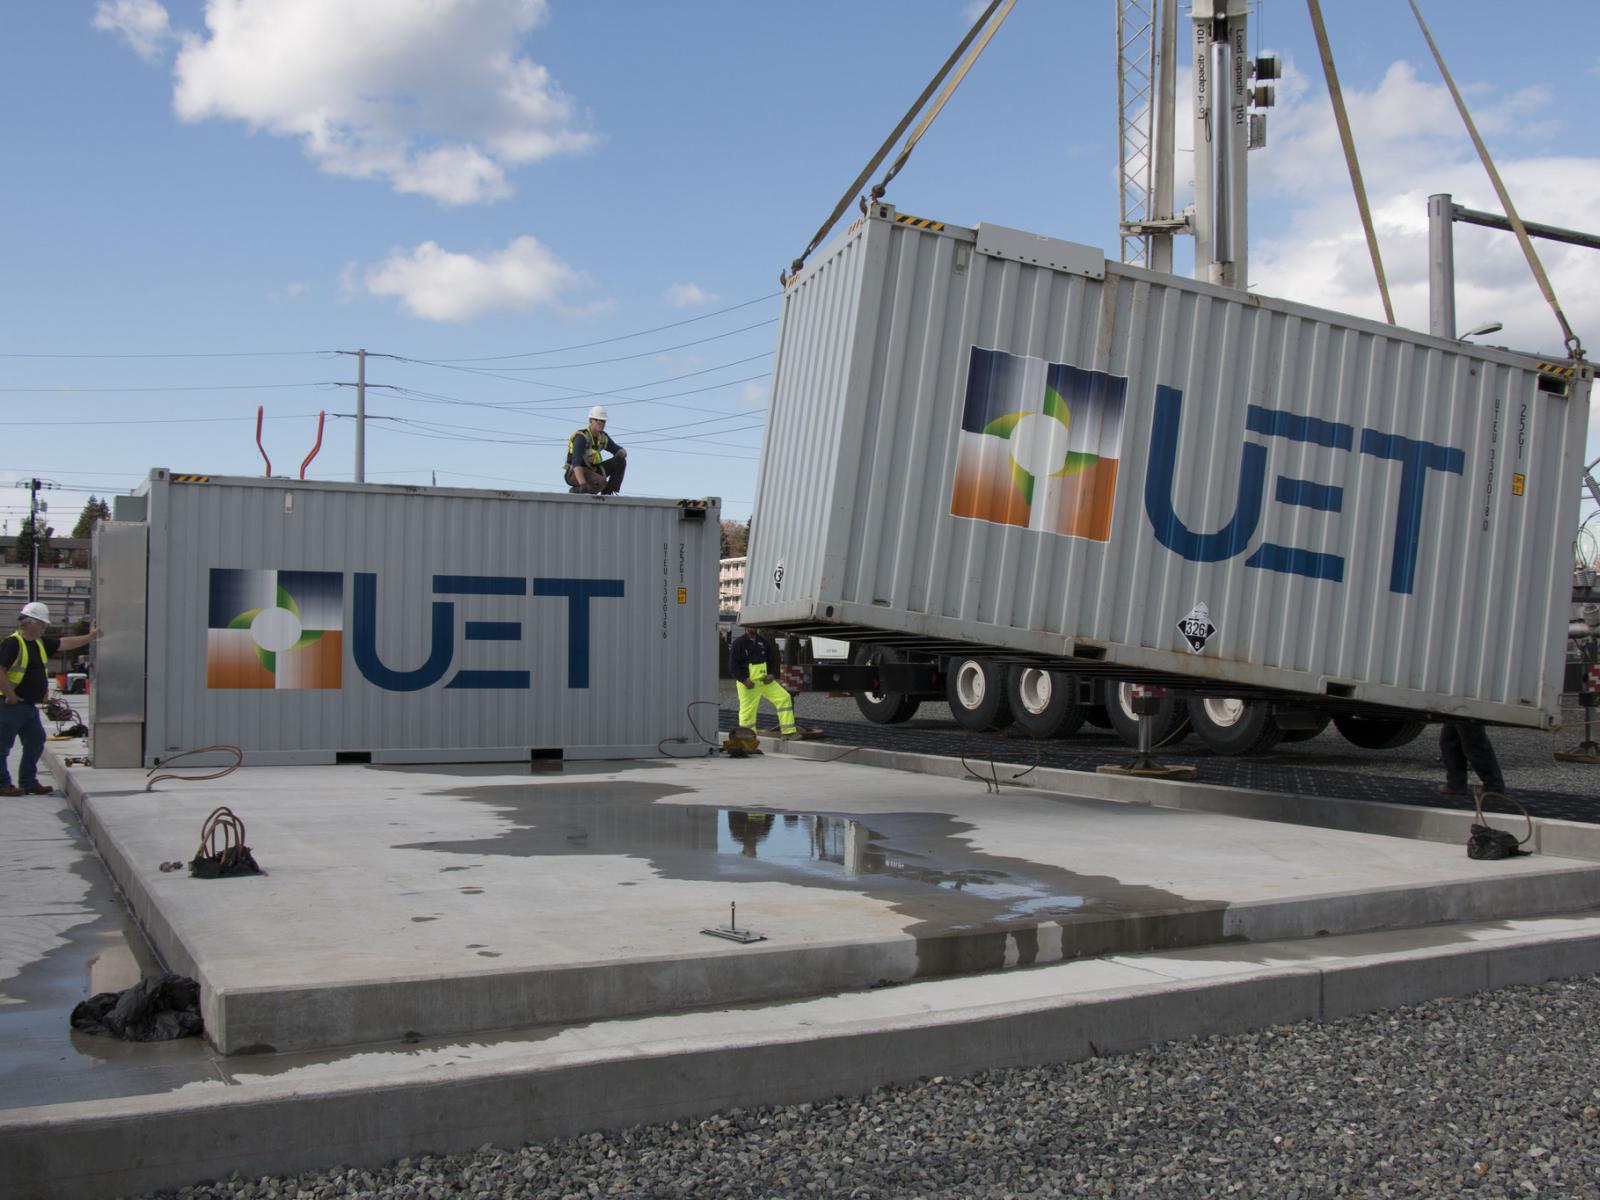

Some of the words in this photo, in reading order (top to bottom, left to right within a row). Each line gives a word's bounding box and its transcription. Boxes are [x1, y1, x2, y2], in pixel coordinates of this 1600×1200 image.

[1236, 28, 1244, 54] Load
[1197, 53, 1206, 93] capacity
[1234, 56, 1244, 96] capacity
[1197, 96, 1206, 120] Lod
[1236, 104, 1244, 119] 110
[1144, 384, 1466, 594] UET
[352, 572, 625, 692] UET
[1186, 621, 1207, 636] 326
